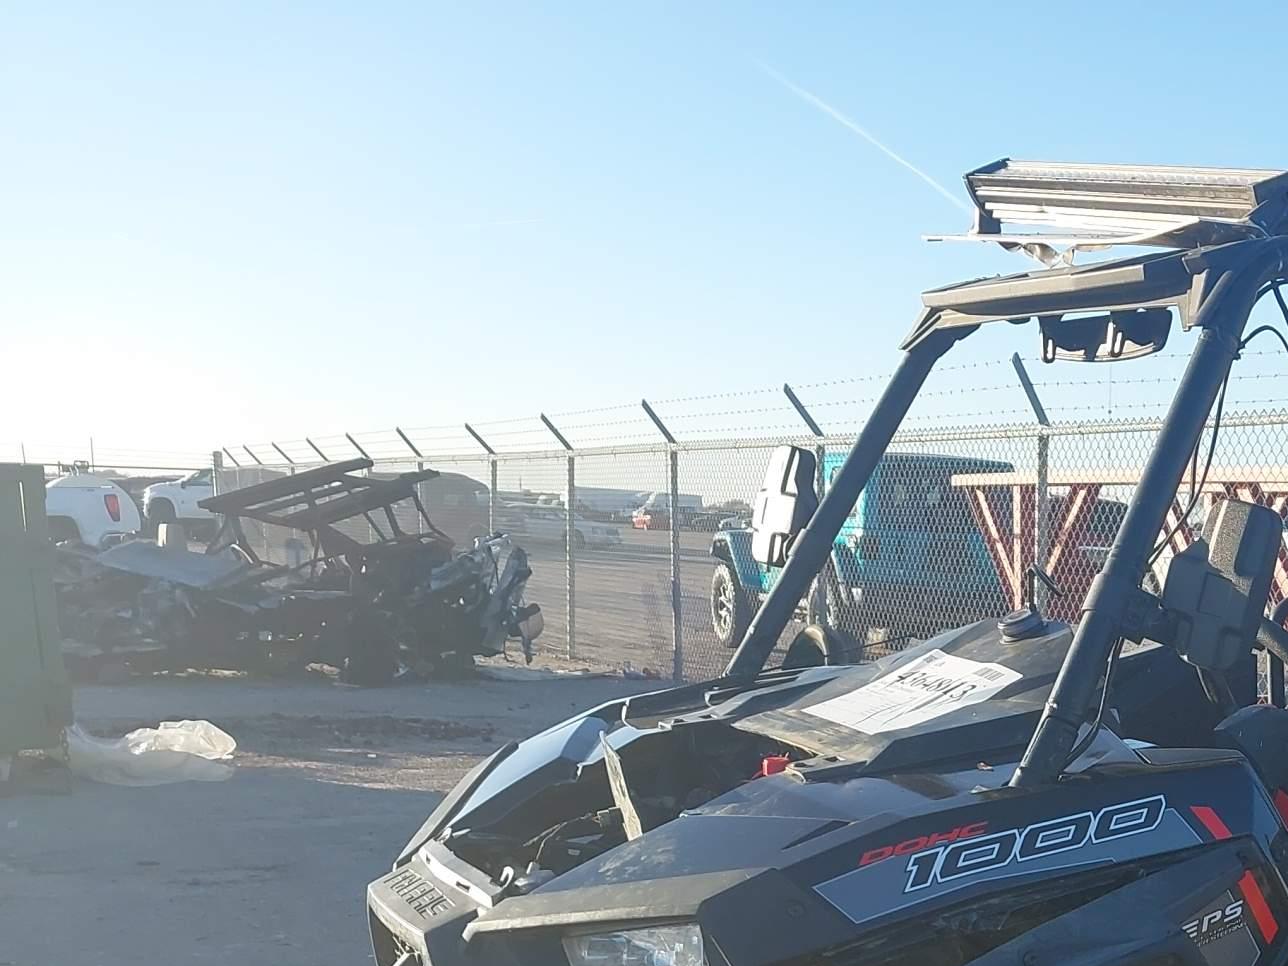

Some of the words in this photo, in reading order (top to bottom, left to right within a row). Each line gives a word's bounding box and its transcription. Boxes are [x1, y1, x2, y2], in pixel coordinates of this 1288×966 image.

[859, 820, 990, 866] DOHC
[904, 795, 1166, 893] 1000
[1181, 899, 1244, 939] EPS
